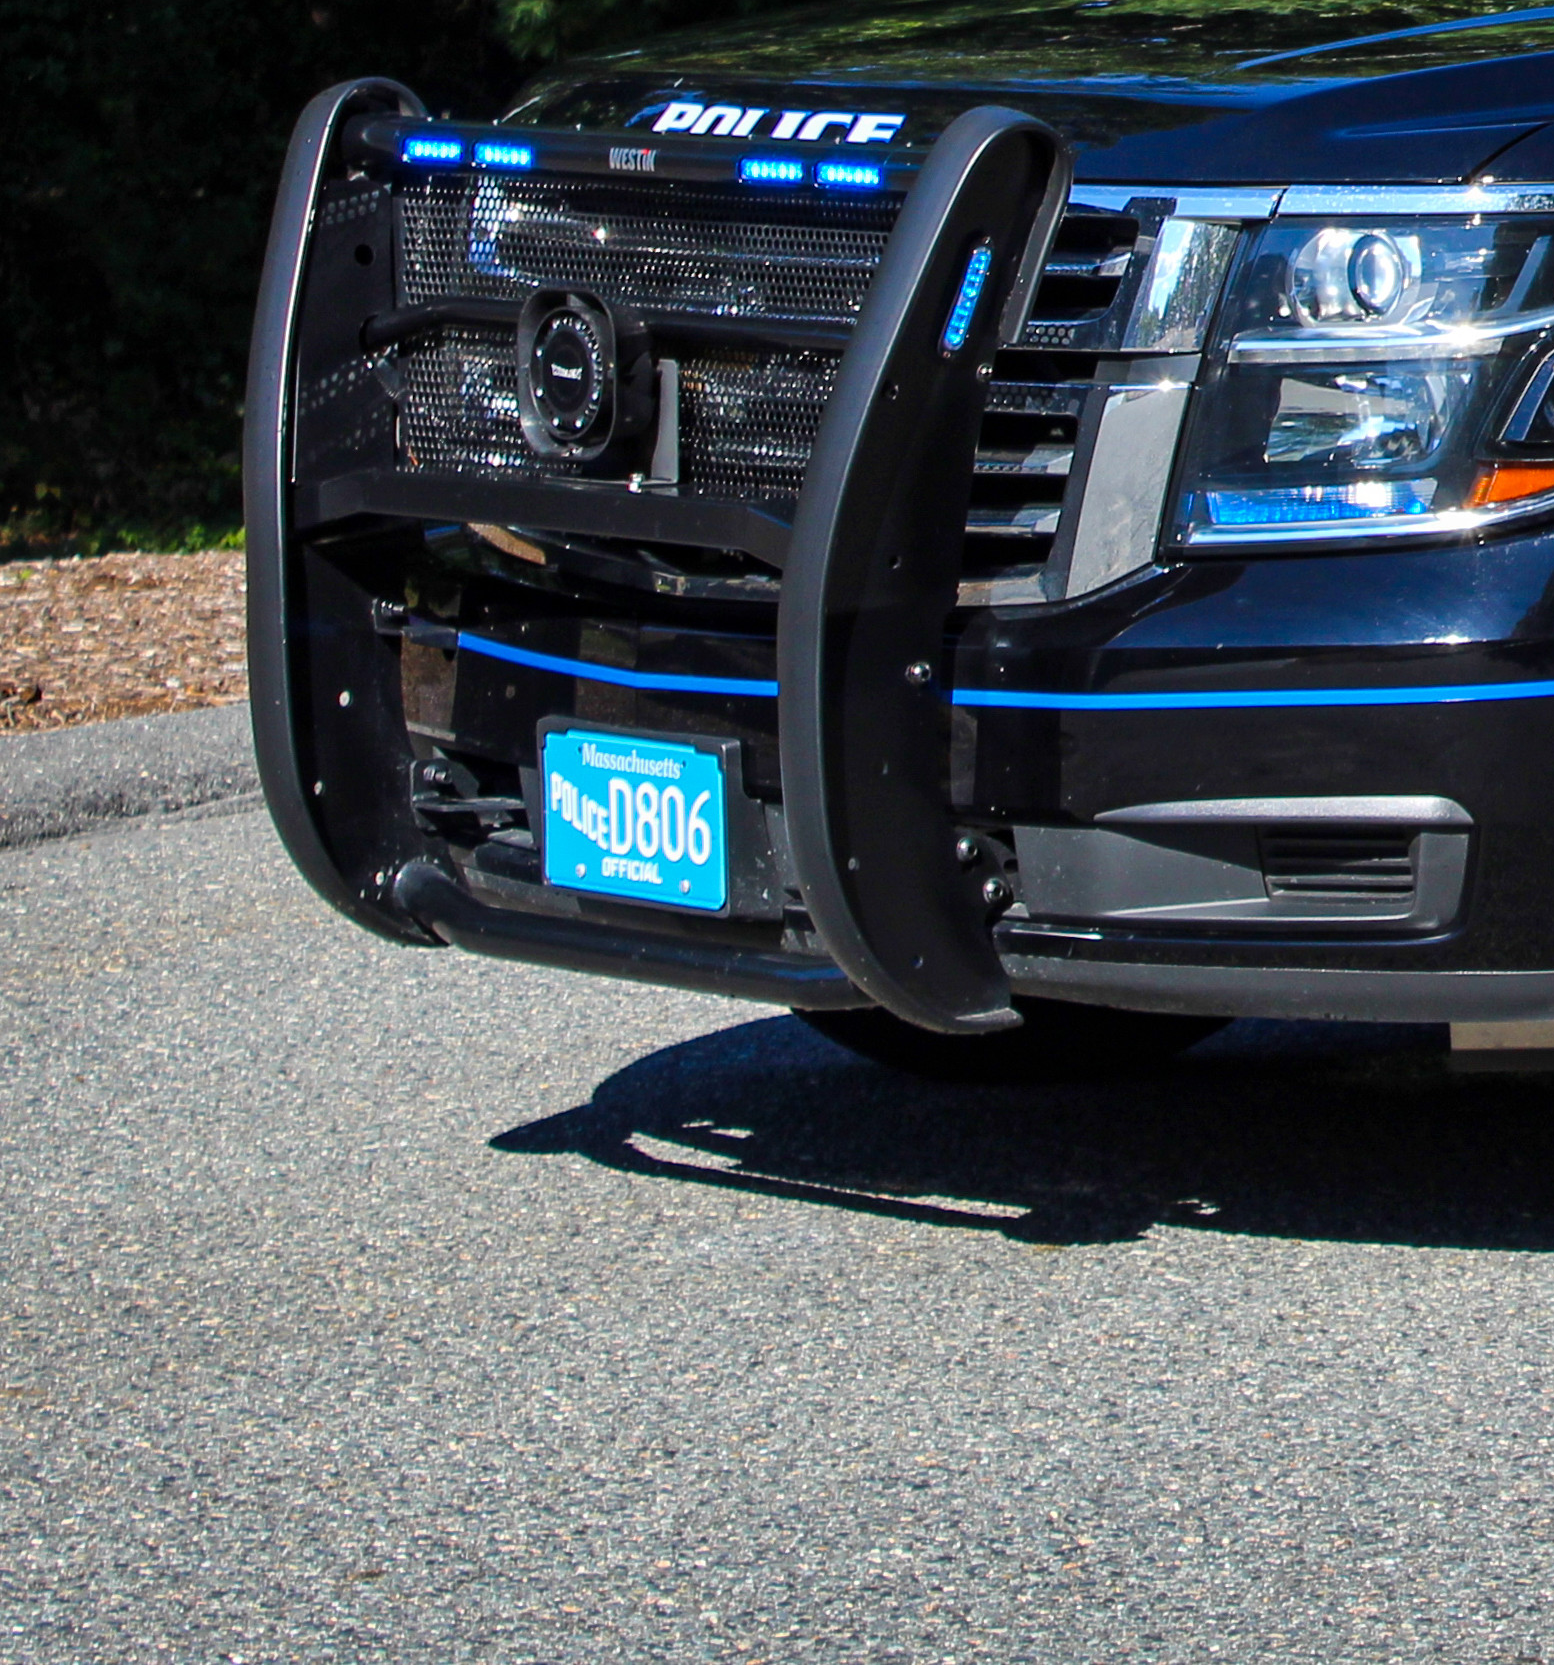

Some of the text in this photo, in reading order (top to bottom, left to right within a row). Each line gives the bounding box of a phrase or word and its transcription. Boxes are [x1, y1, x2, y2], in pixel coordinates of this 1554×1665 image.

[581, 742, 682, 780] Massachusetts
[550, 771, 712, 866] POLICE D806
[602, 856, 663, 884] OFFICIAL
